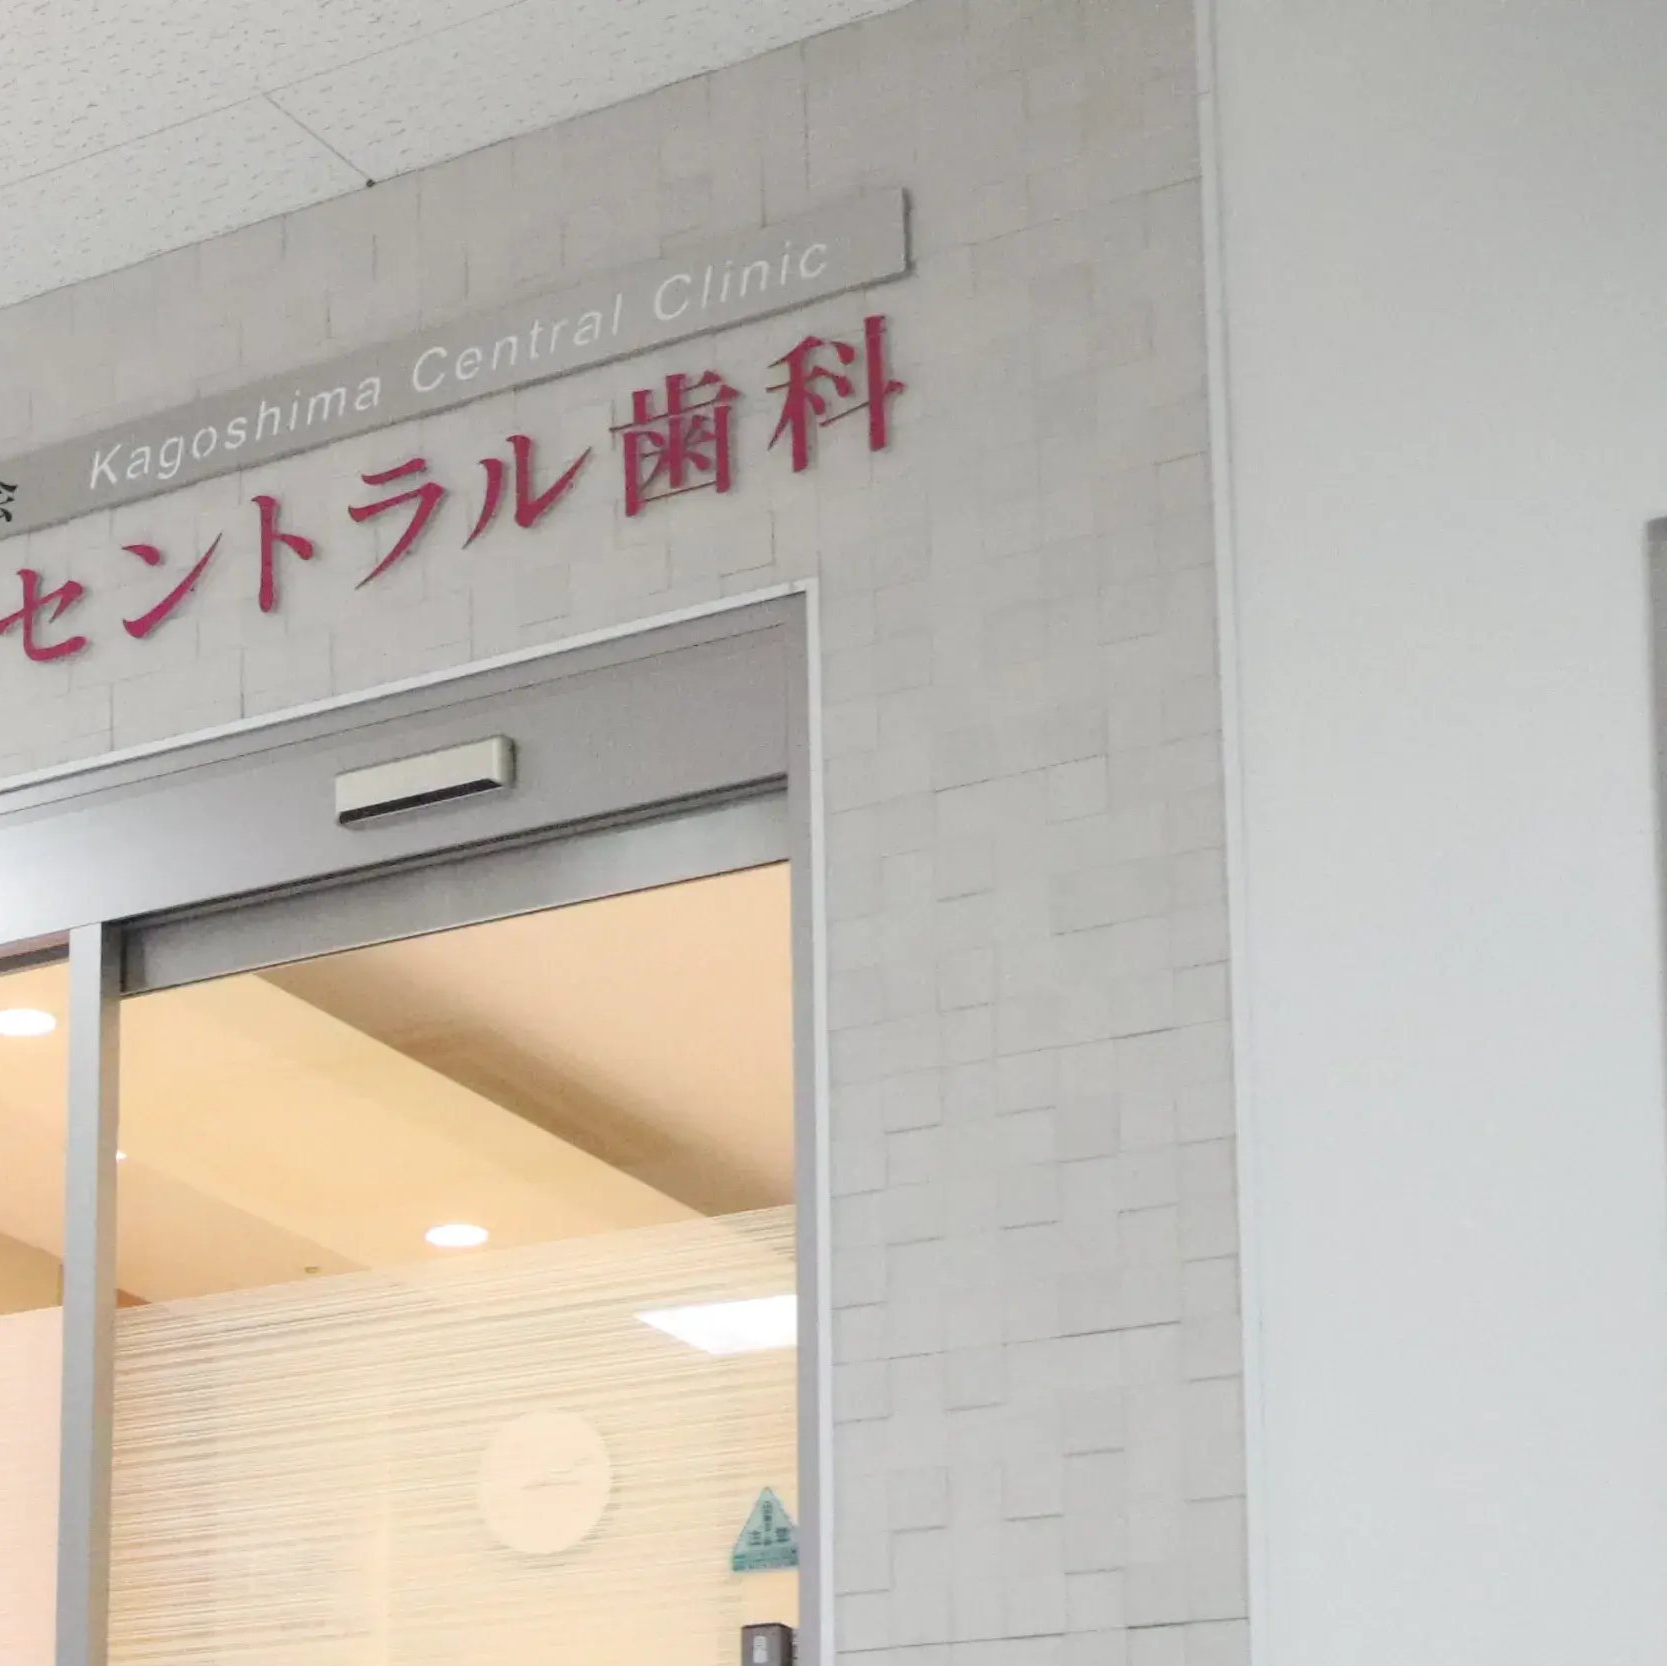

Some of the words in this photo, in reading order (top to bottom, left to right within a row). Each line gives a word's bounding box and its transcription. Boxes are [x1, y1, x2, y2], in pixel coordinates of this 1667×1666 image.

[87, 369, 383, 494] Kagoshima
[410, 293, 624, 395] Central
[652, 233, 830, 323] Clinic
